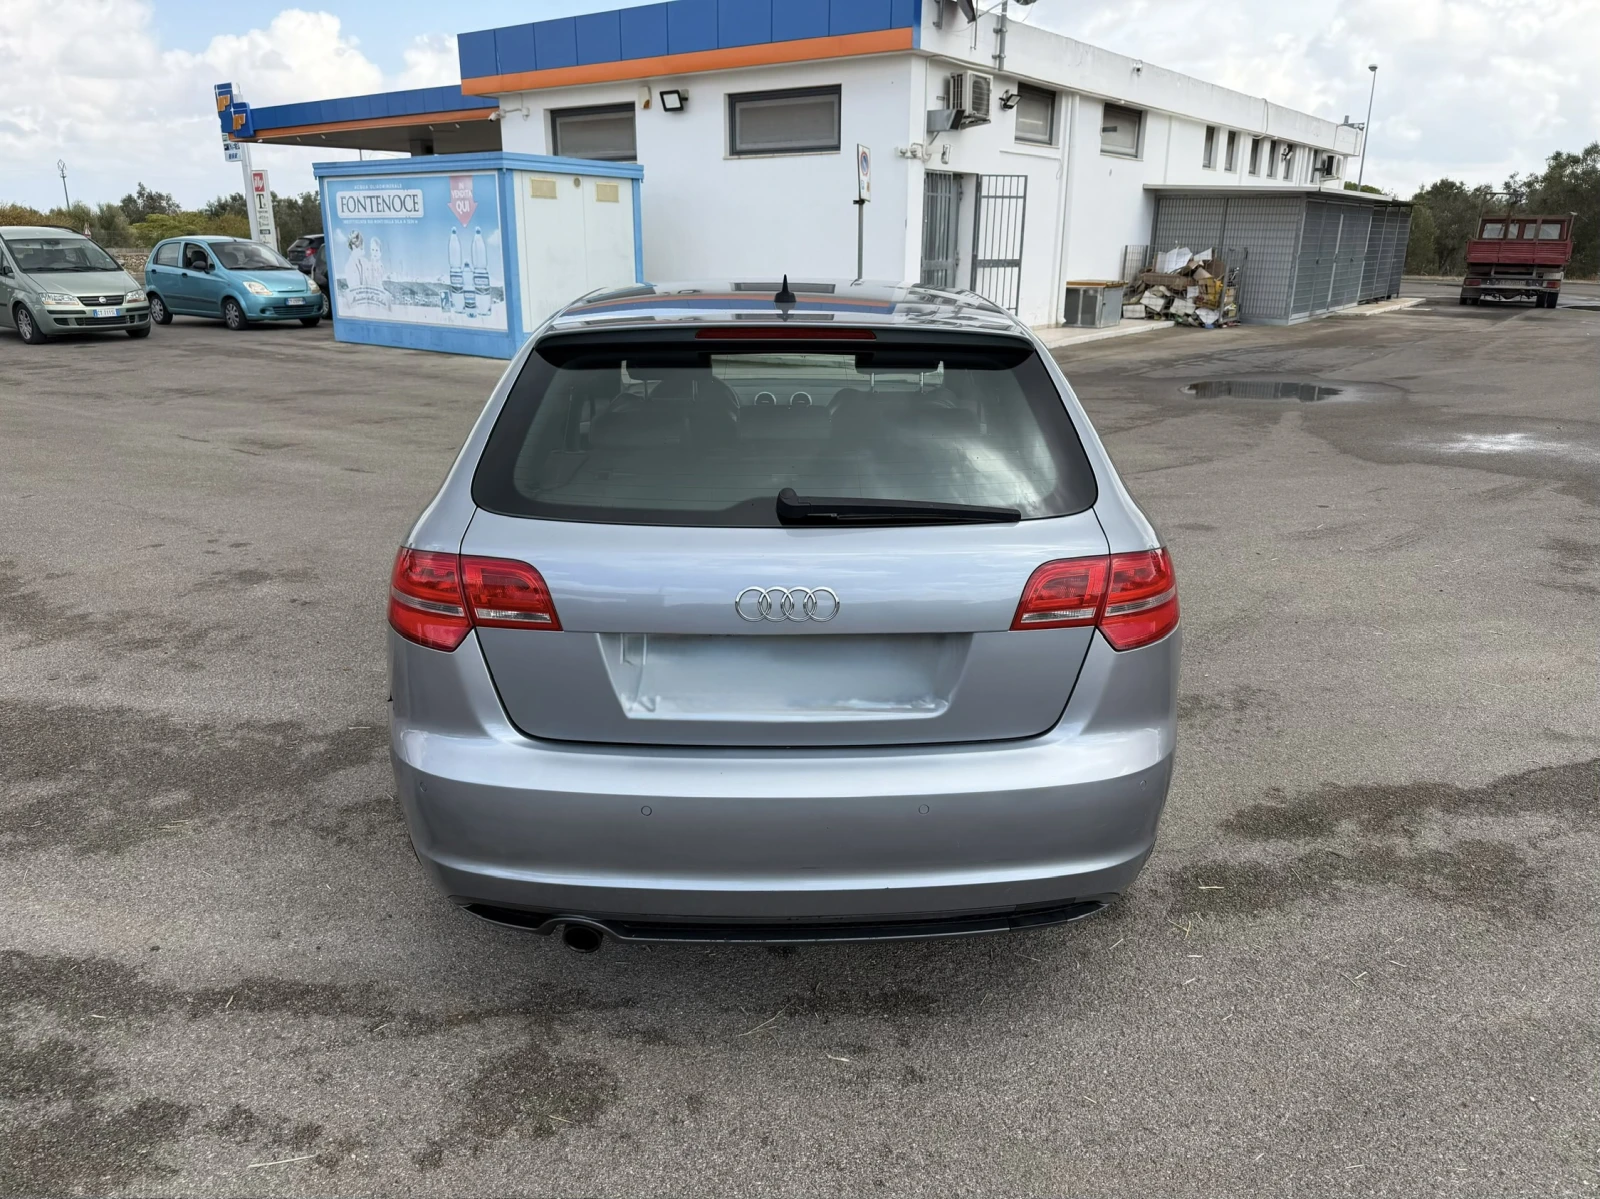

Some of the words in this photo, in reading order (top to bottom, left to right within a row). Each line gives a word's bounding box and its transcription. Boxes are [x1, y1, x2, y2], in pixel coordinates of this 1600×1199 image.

[254, 175, 264, 190] illy
[340, 194, 419, 213] FONTENOCE
[455, 200, 470, 215] QUI
